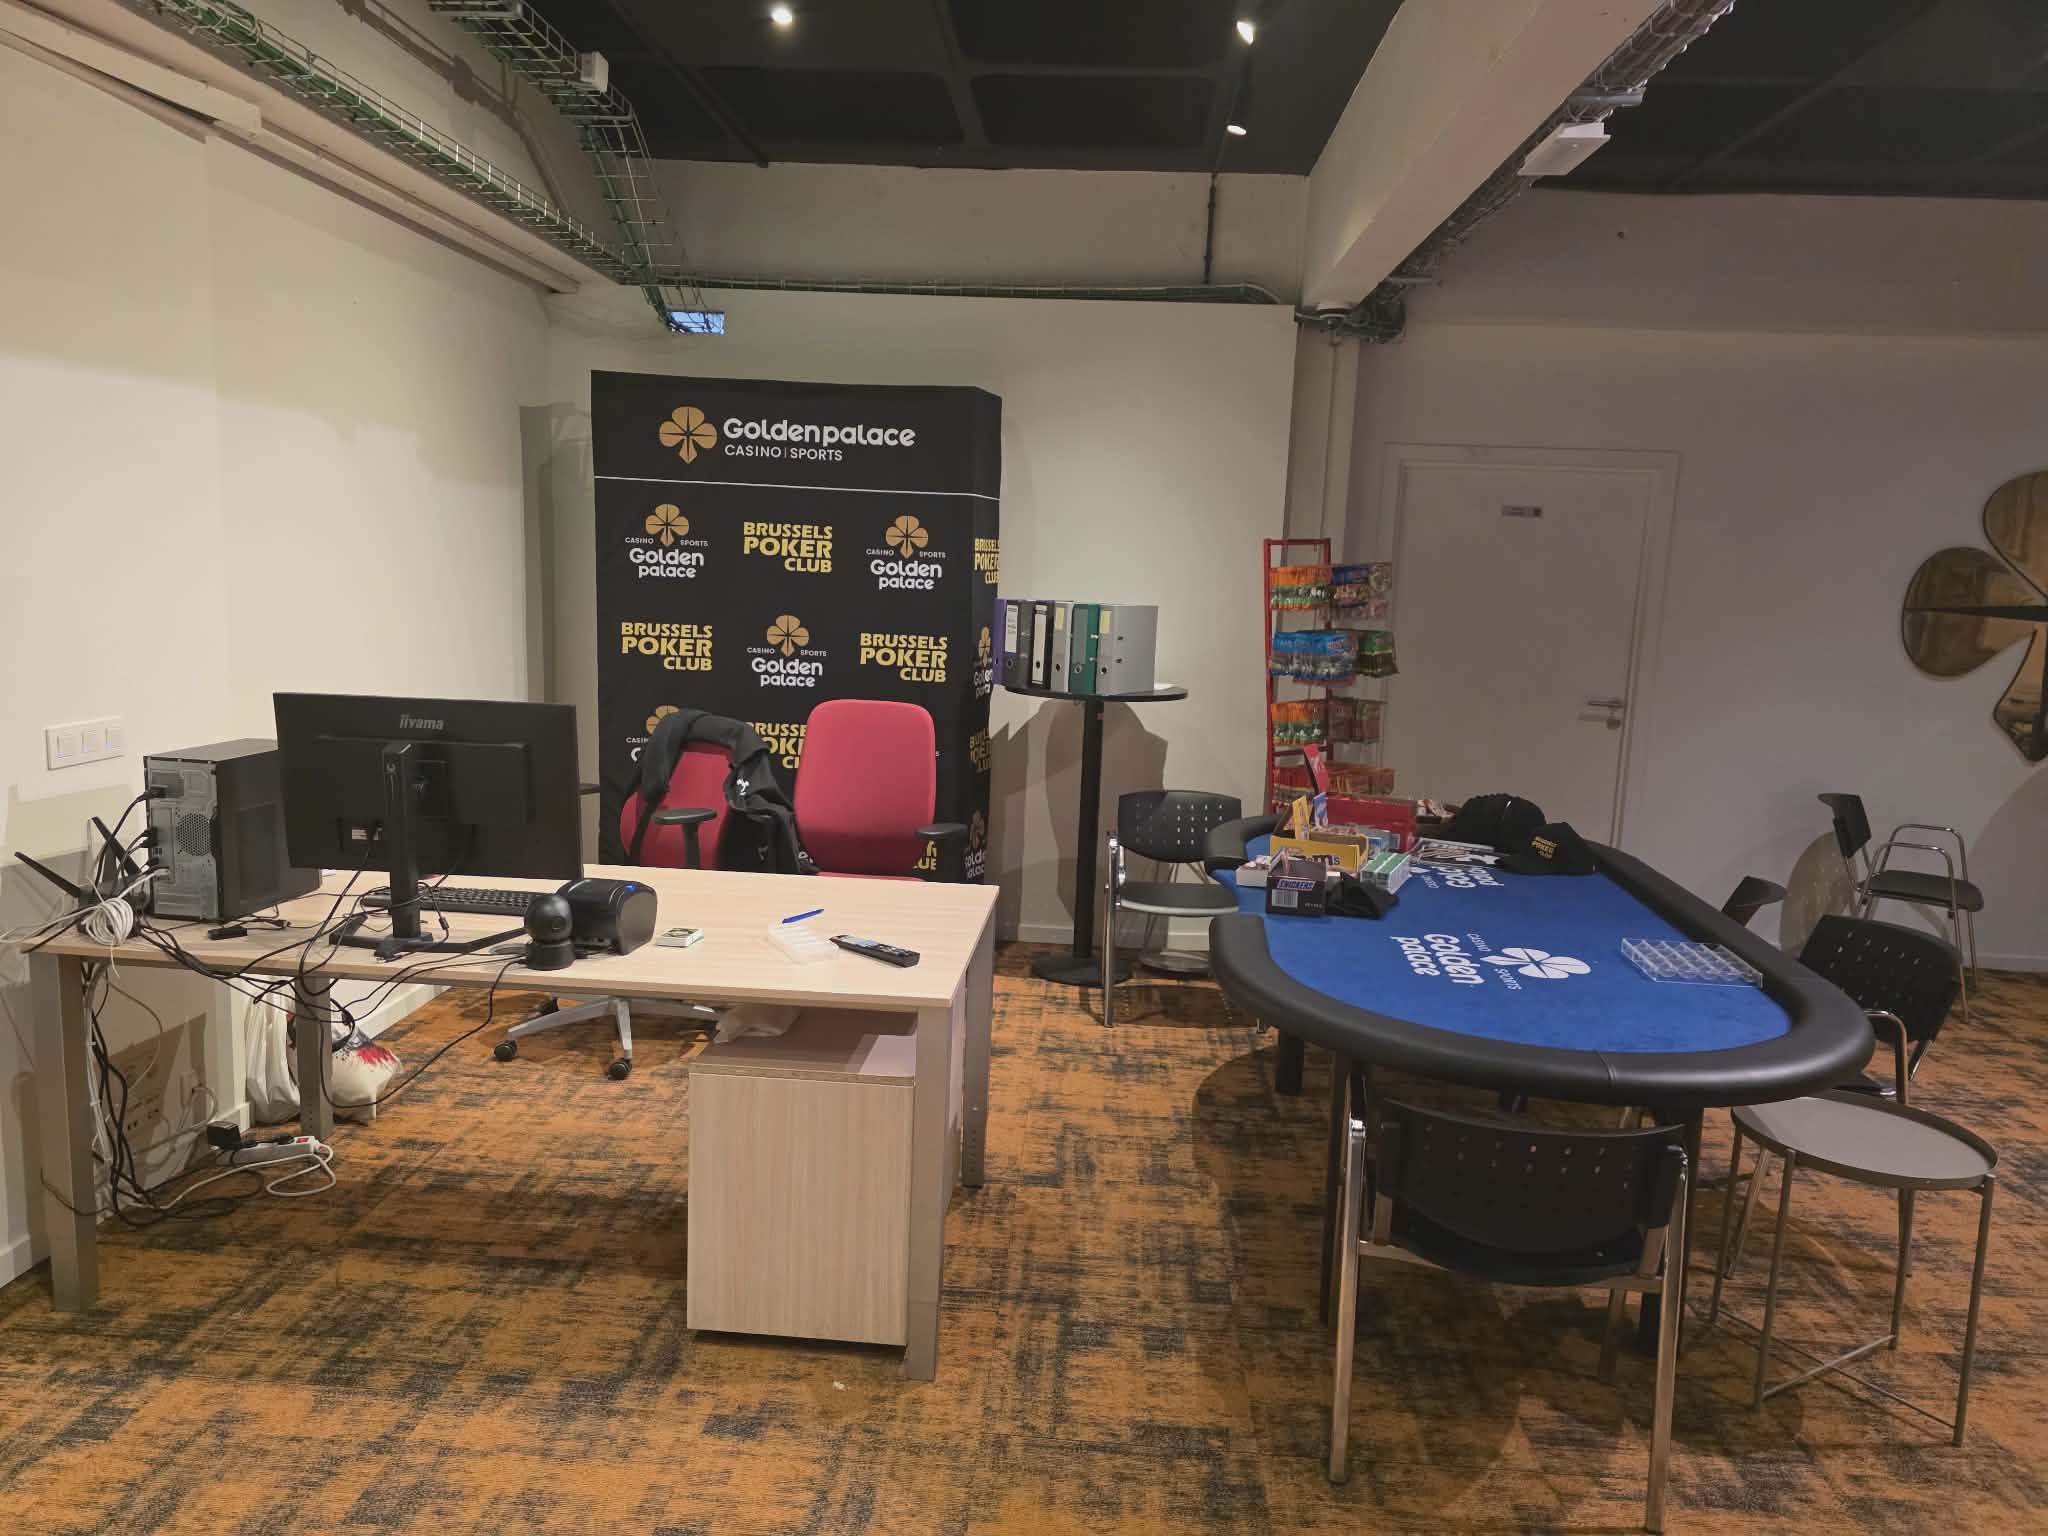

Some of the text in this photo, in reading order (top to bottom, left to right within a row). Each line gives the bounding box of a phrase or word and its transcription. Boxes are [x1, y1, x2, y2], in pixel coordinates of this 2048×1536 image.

[723, 417, 916, 447] Goldenpalace
[724, 444, 843, 461] CASINO SPORTS
[743, 521, 833, 540] BRUSSELS
[680, 539, 709, 547] SPORTS
[743, 536, 833, 559] POKER
[629, 547, 705, 567] Golden
[865, 548, 947, 559] CASINO SPORTS
[638, 564, 697, 579] palace
[784, 557, 833, 573] CLUB
[870, 559, 943, 579] Golden
[878, 576, 936, 590] palace
[621, 621, 713, 639] BRUSSELS
[621, 636, 713, 657] POKER
[860, 632, 948, 651] BRUSSELS
[746, 647, 827, 657] CASINO SPORTS
[859, 647, 947, 669] POKER
[663, 656, 713, 672] CLUB
[752, 657, 824, 677] Golden
[760, 673, 816, 688] palace
[900, 667, 947, 683] CLUB
[1390, 935, 1441, 977] palace
[1424, 933, 1485, 985] Golden
